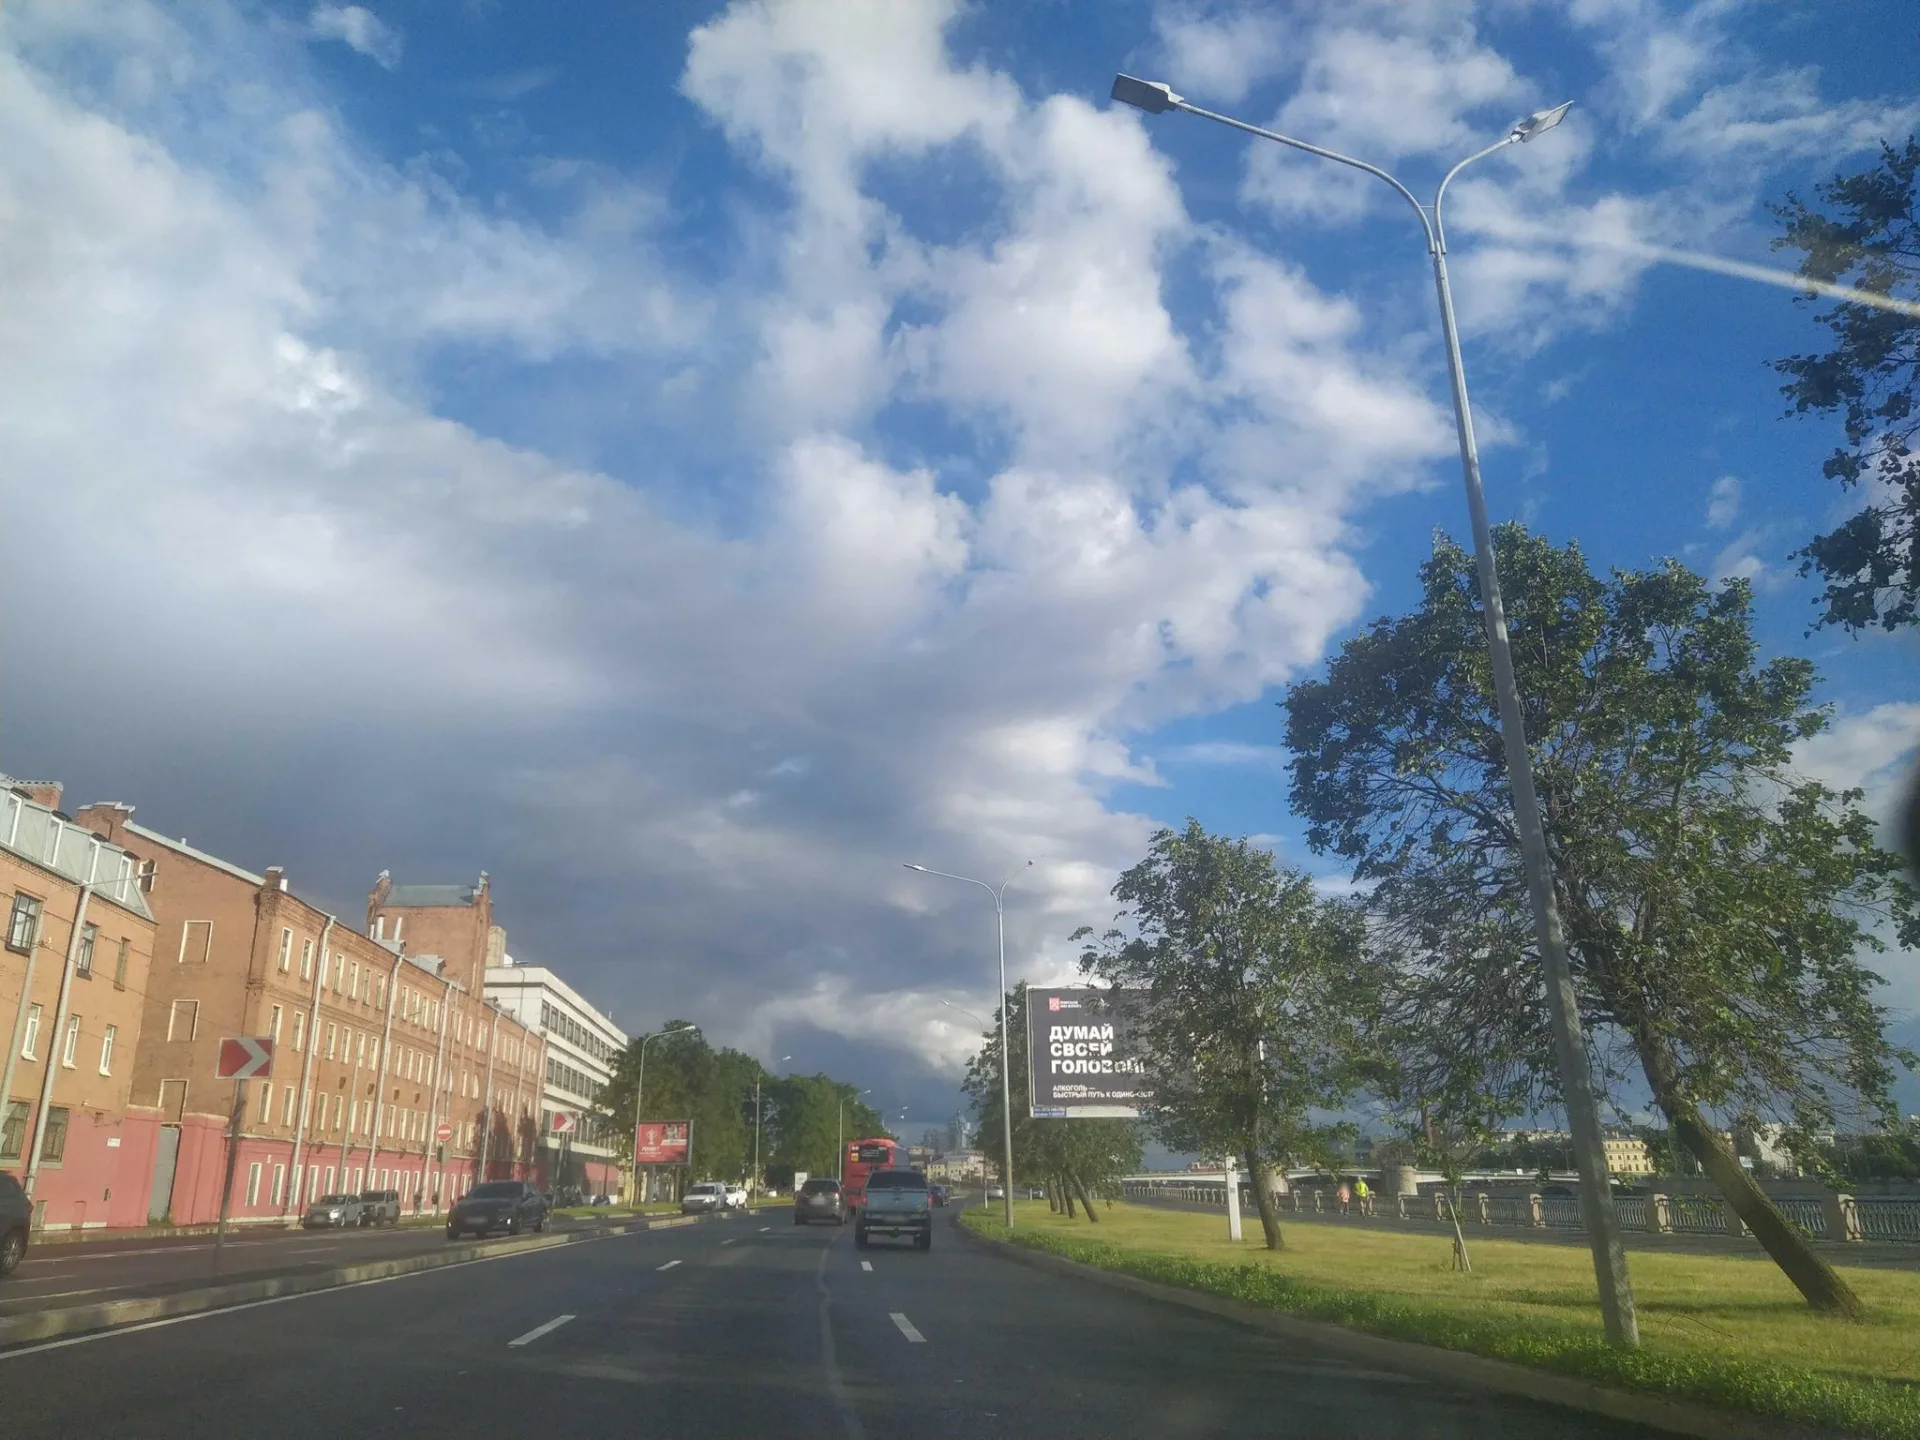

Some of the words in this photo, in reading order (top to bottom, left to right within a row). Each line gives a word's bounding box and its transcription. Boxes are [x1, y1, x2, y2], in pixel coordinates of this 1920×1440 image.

[1049, 1022, 1114, 1042] ДУМАЙ
[1053, 1091, 1087, 1099] БЫСТРЫЙ
[1087, 1091, 1105, 1099] ПУТЬ
